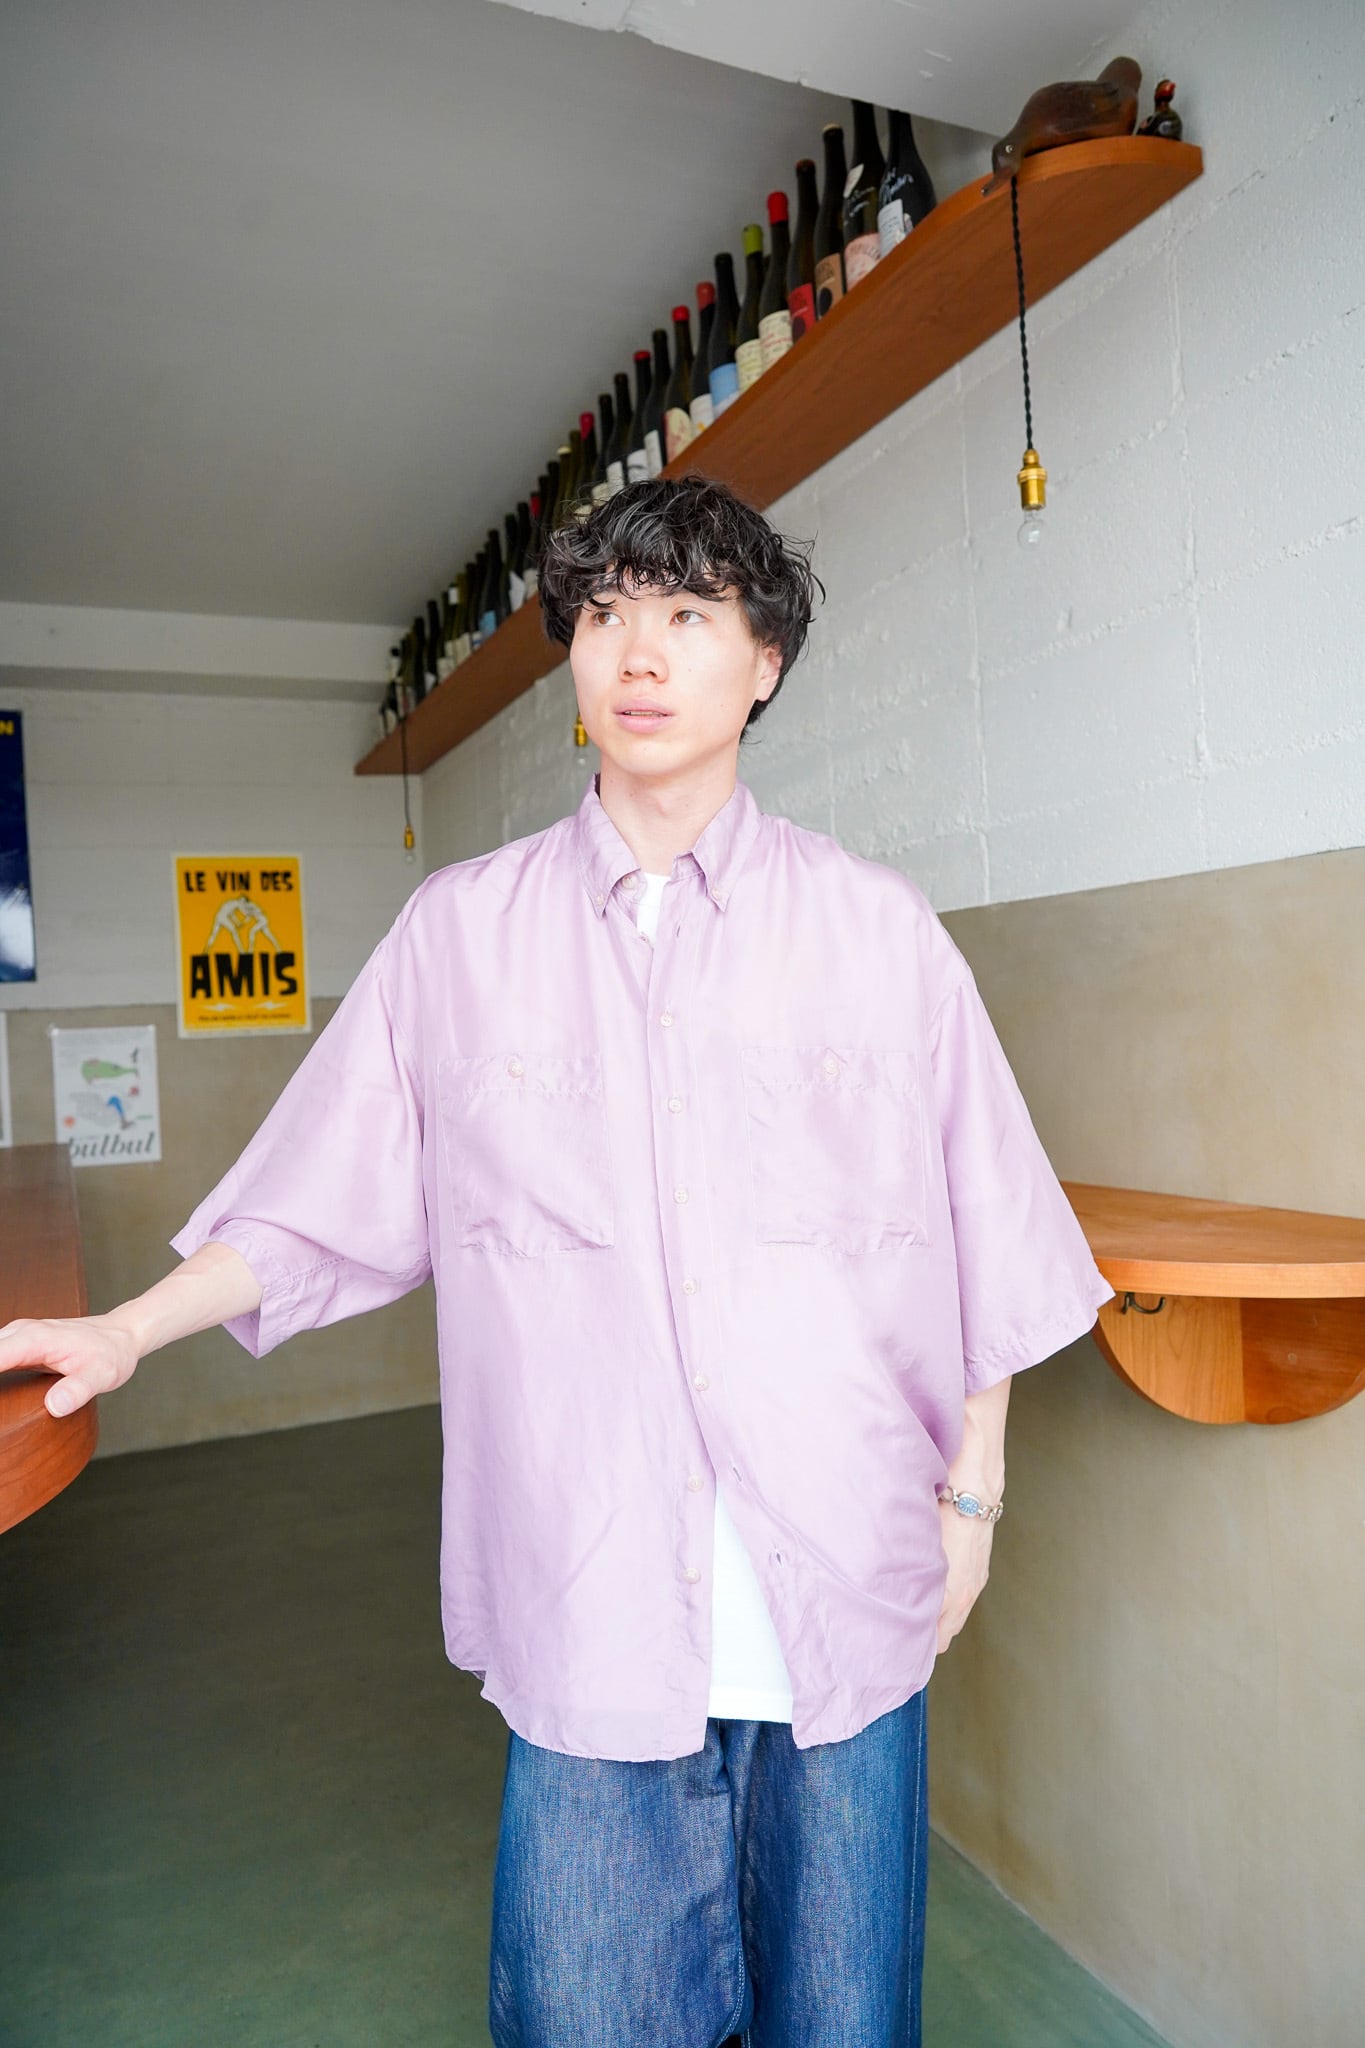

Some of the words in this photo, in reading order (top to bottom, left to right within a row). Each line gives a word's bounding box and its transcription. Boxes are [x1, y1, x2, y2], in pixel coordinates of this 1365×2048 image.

[184, 871, 207, 892] LE
[216, 871, 251, 892] VIN
[260, 871, 294, 892] DES
[189, 952, 298, 999] AMIS
